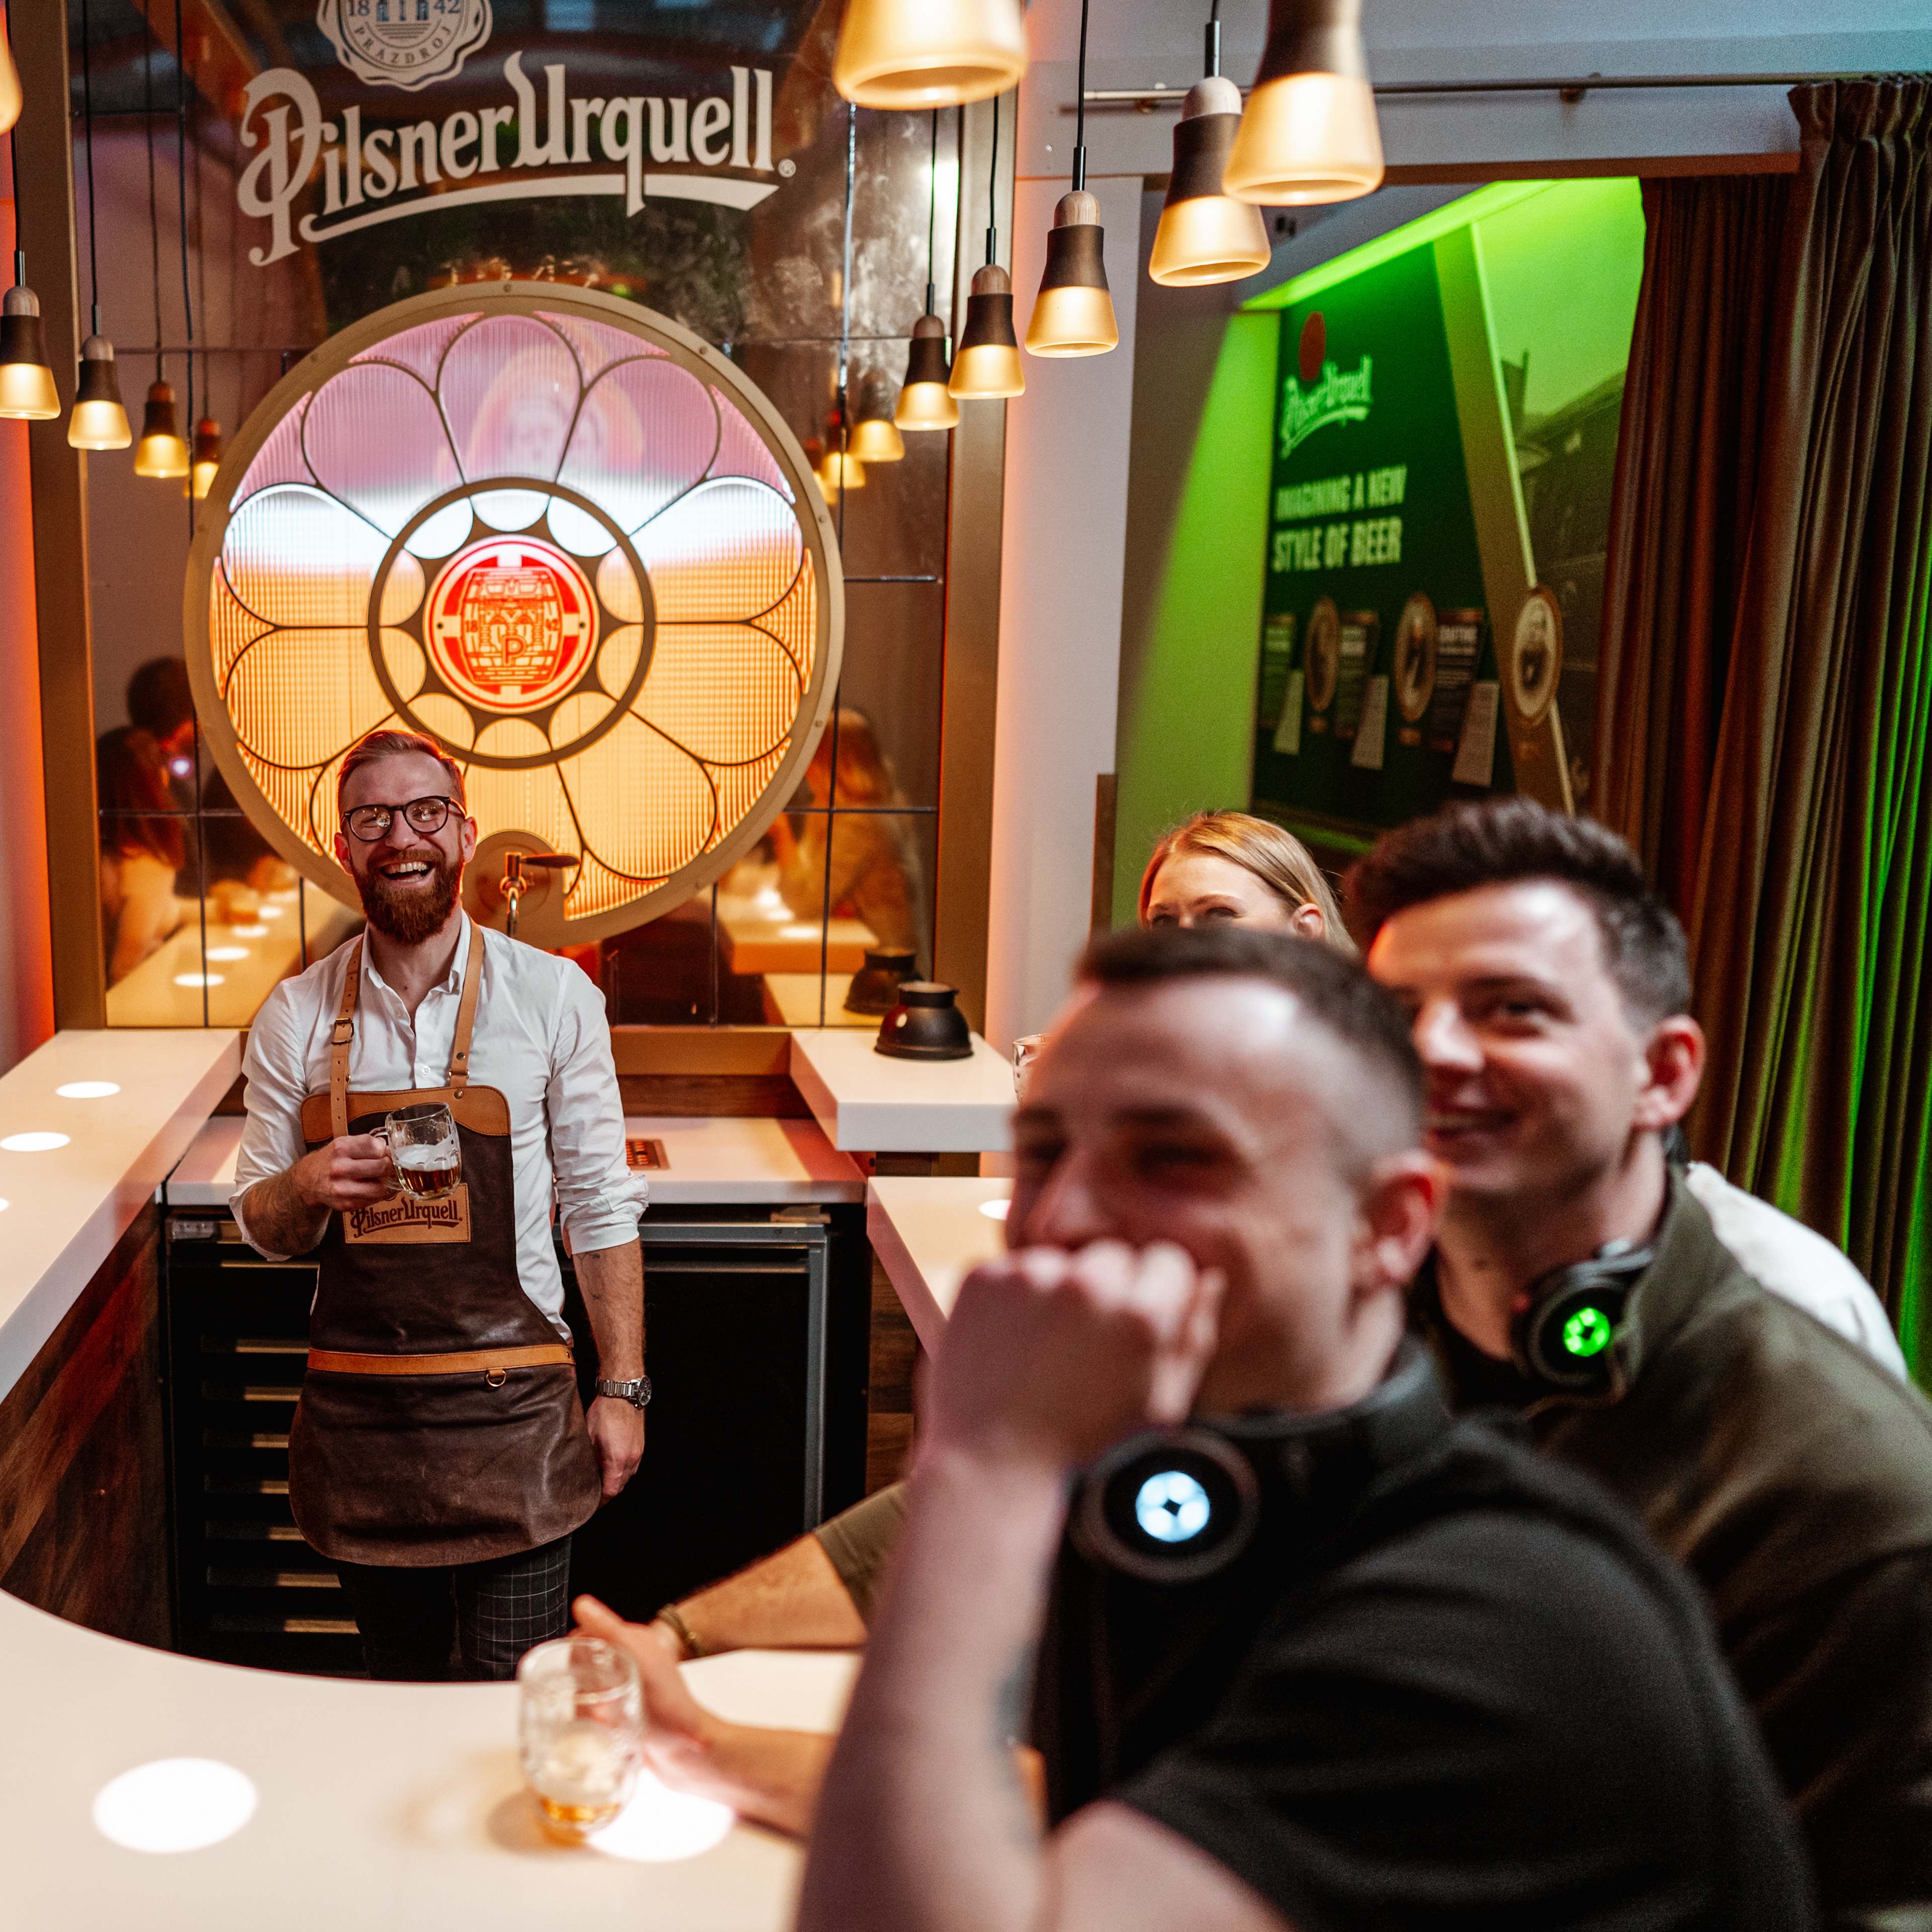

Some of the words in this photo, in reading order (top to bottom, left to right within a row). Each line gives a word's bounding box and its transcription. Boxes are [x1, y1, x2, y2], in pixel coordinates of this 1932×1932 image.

[350, 0, 370, 16] 18
[434, 0, 461, 14] 42
[354, 25, 451, 64] PRAZDROJ
[1353, 471, 1364, 510] A
[1367, 463, 1407, 509] NEW
[1273, 526, 1322, 573] STYLE
[1324, 521, 1349, 569] OF
[1351, 516, 1402, 567] BEER
